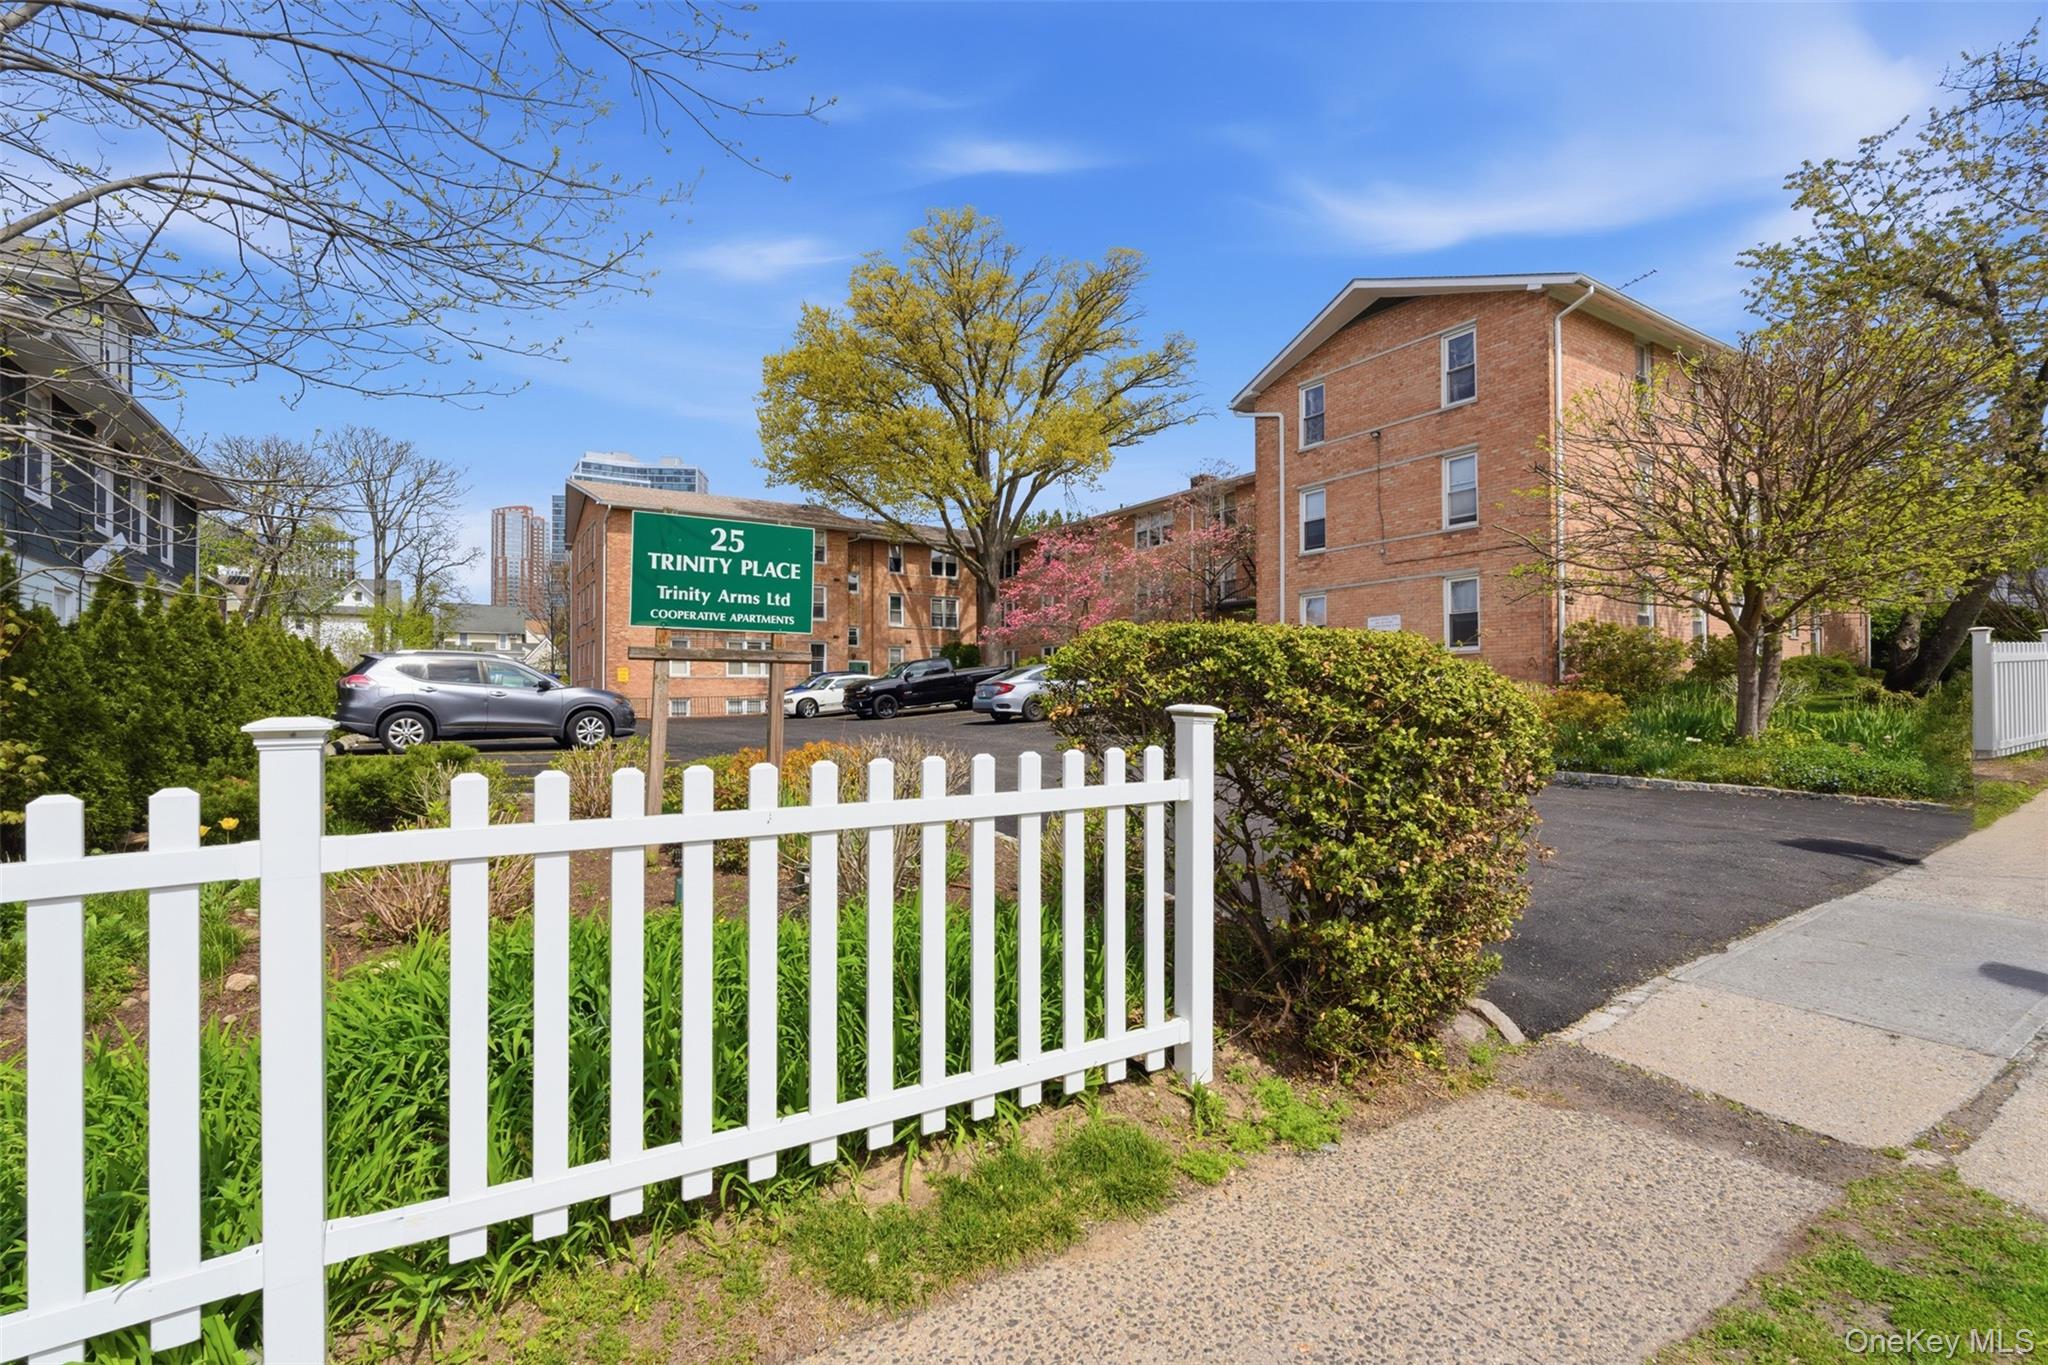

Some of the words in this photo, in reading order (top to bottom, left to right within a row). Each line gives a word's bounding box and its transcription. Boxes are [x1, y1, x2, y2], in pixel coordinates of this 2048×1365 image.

[710, 527, 745, 553] 25
[648, 552, 732, 574] TRINITY
[740, 559, 801, 579] PLACE
[657, 585, 711, 605] Trinity
[718, 589, 760, 605] Arms
[767, 592, 791, 607] Ltd
[650, 608, 726, 622] COOPERATIVE
[729, 613, 795, 625] APARTMENTS
